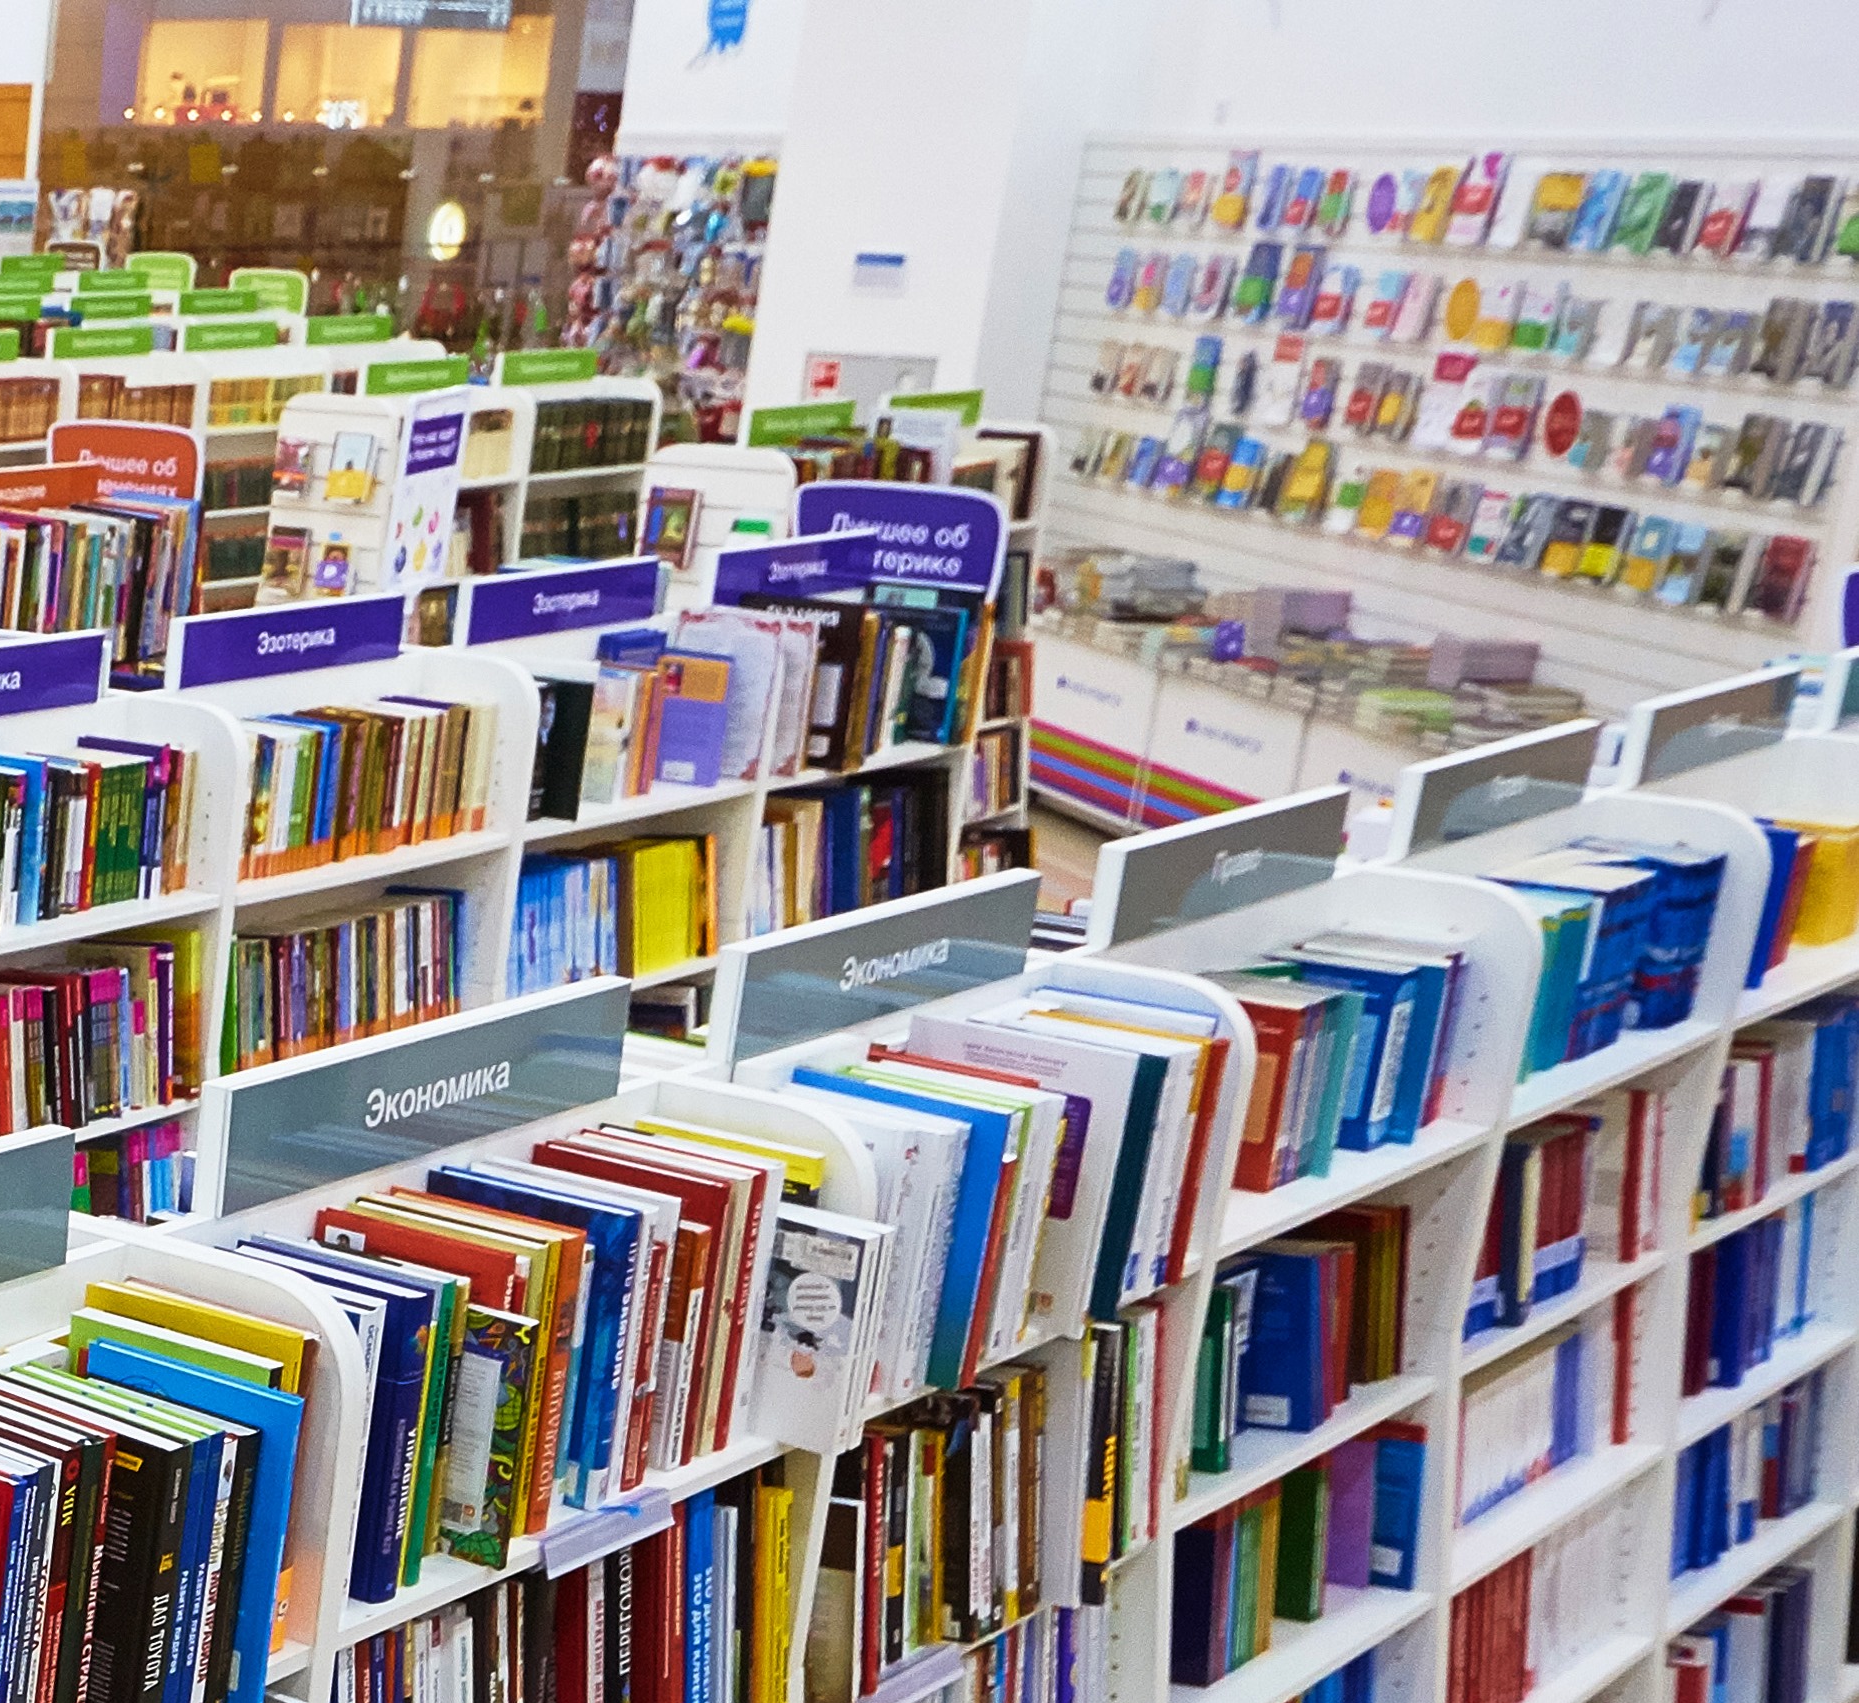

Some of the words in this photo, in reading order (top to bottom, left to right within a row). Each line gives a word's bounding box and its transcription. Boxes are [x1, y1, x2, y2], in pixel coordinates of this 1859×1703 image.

[934, 523, 970, 547] об
[533, 590, 599, 614] Эзотерика
[258, 628, 335, 654] Эзотерика
[839, 938, 950, 992] Экономика
[366, 1062, 509, 1127] Экономика
